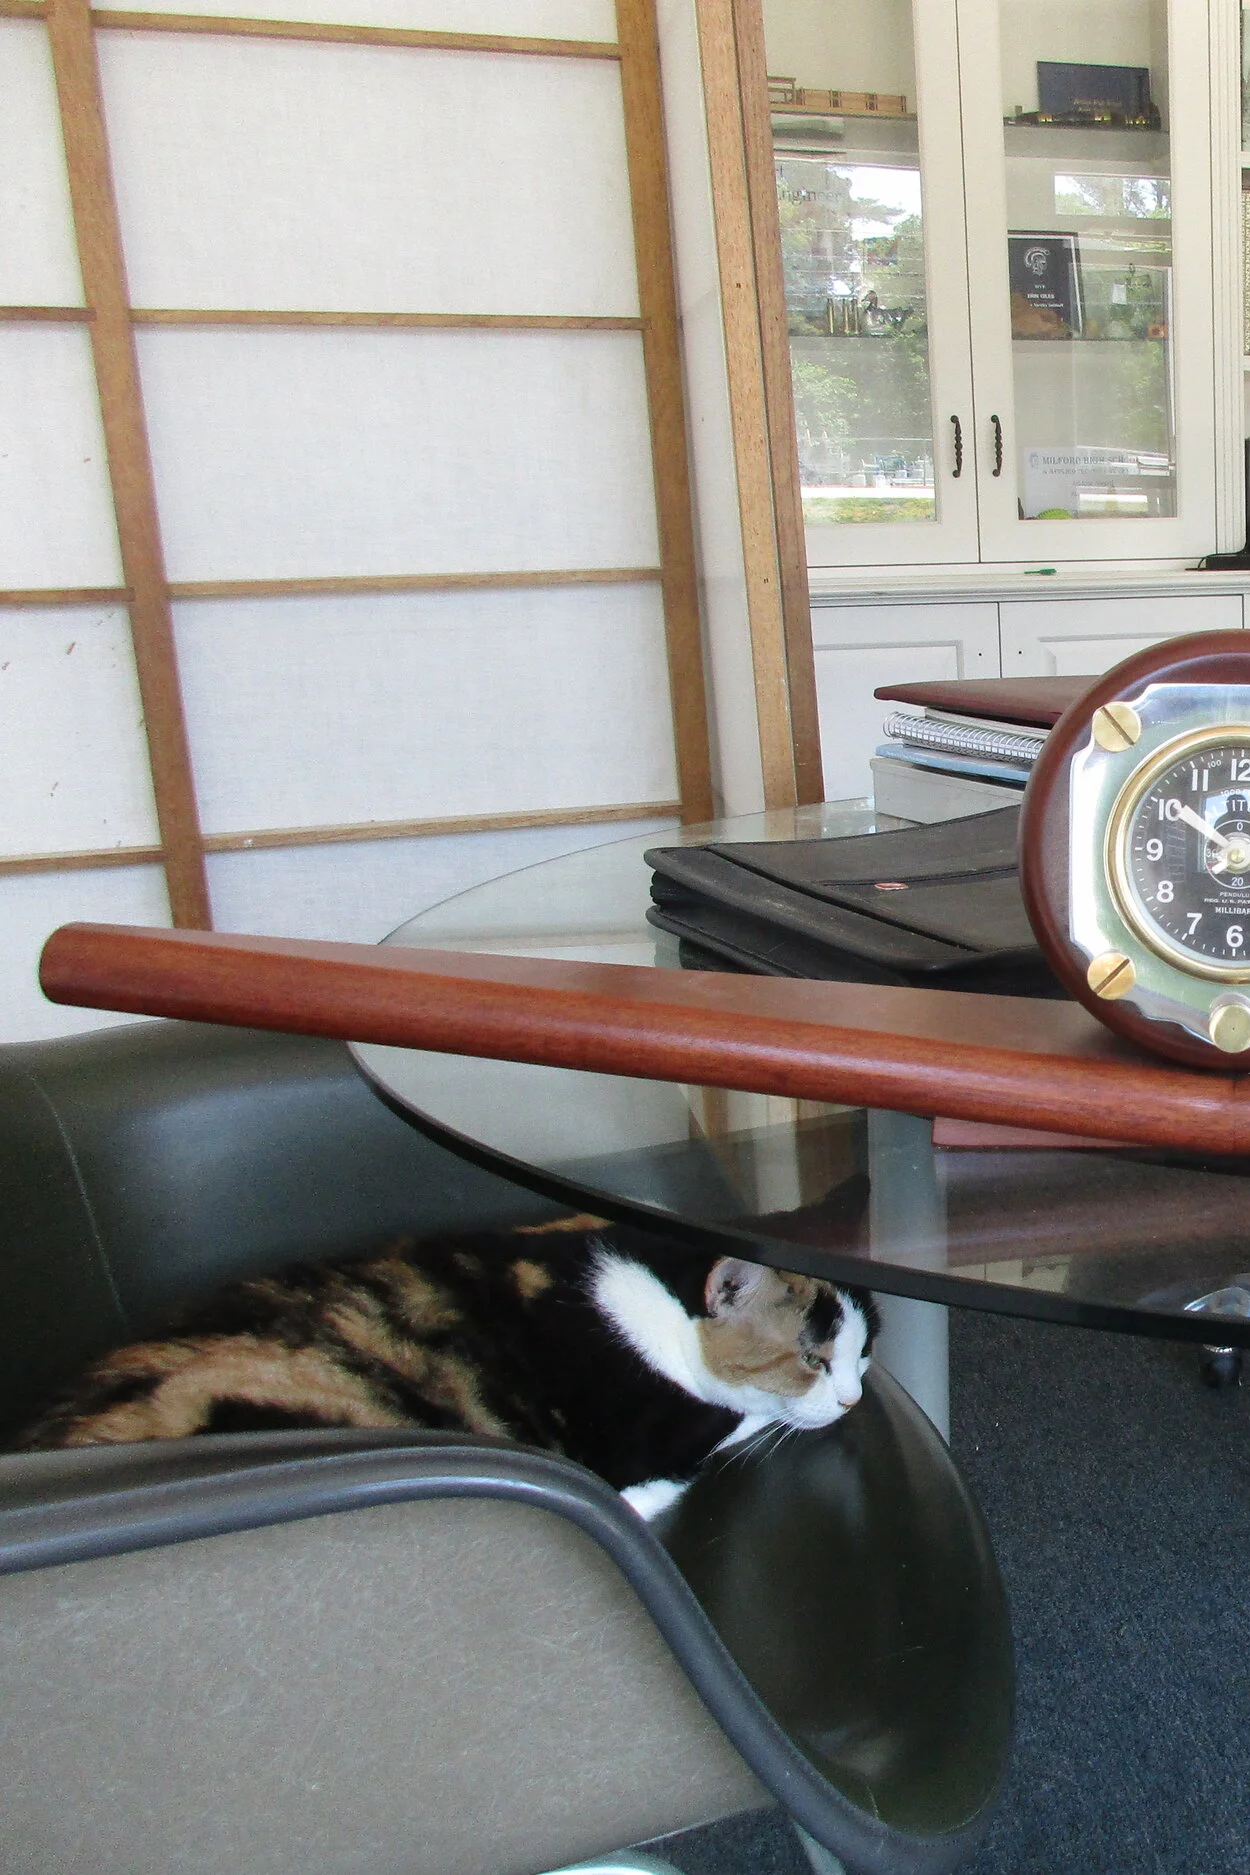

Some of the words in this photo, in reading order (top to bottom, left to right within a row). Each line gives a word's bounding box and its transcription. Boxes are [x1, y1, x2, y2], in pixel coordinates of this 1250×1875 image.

[1042, 456, 1080, 465] MILFORD
[1207, 759, 1222, 769] 100
[1191, 768, 1209, 791] 11
[1158, 798, 1183, 822] 10
[1236, 821, 1244, 832] 0
[1146, 838, 1164, 862] 9
[1156, 880, 1174, 903] 8
[1231, 876, 1244, 887] 20
[1186, 912, 1203, 935] 7
[1226, 925, 1244, 948] 6
